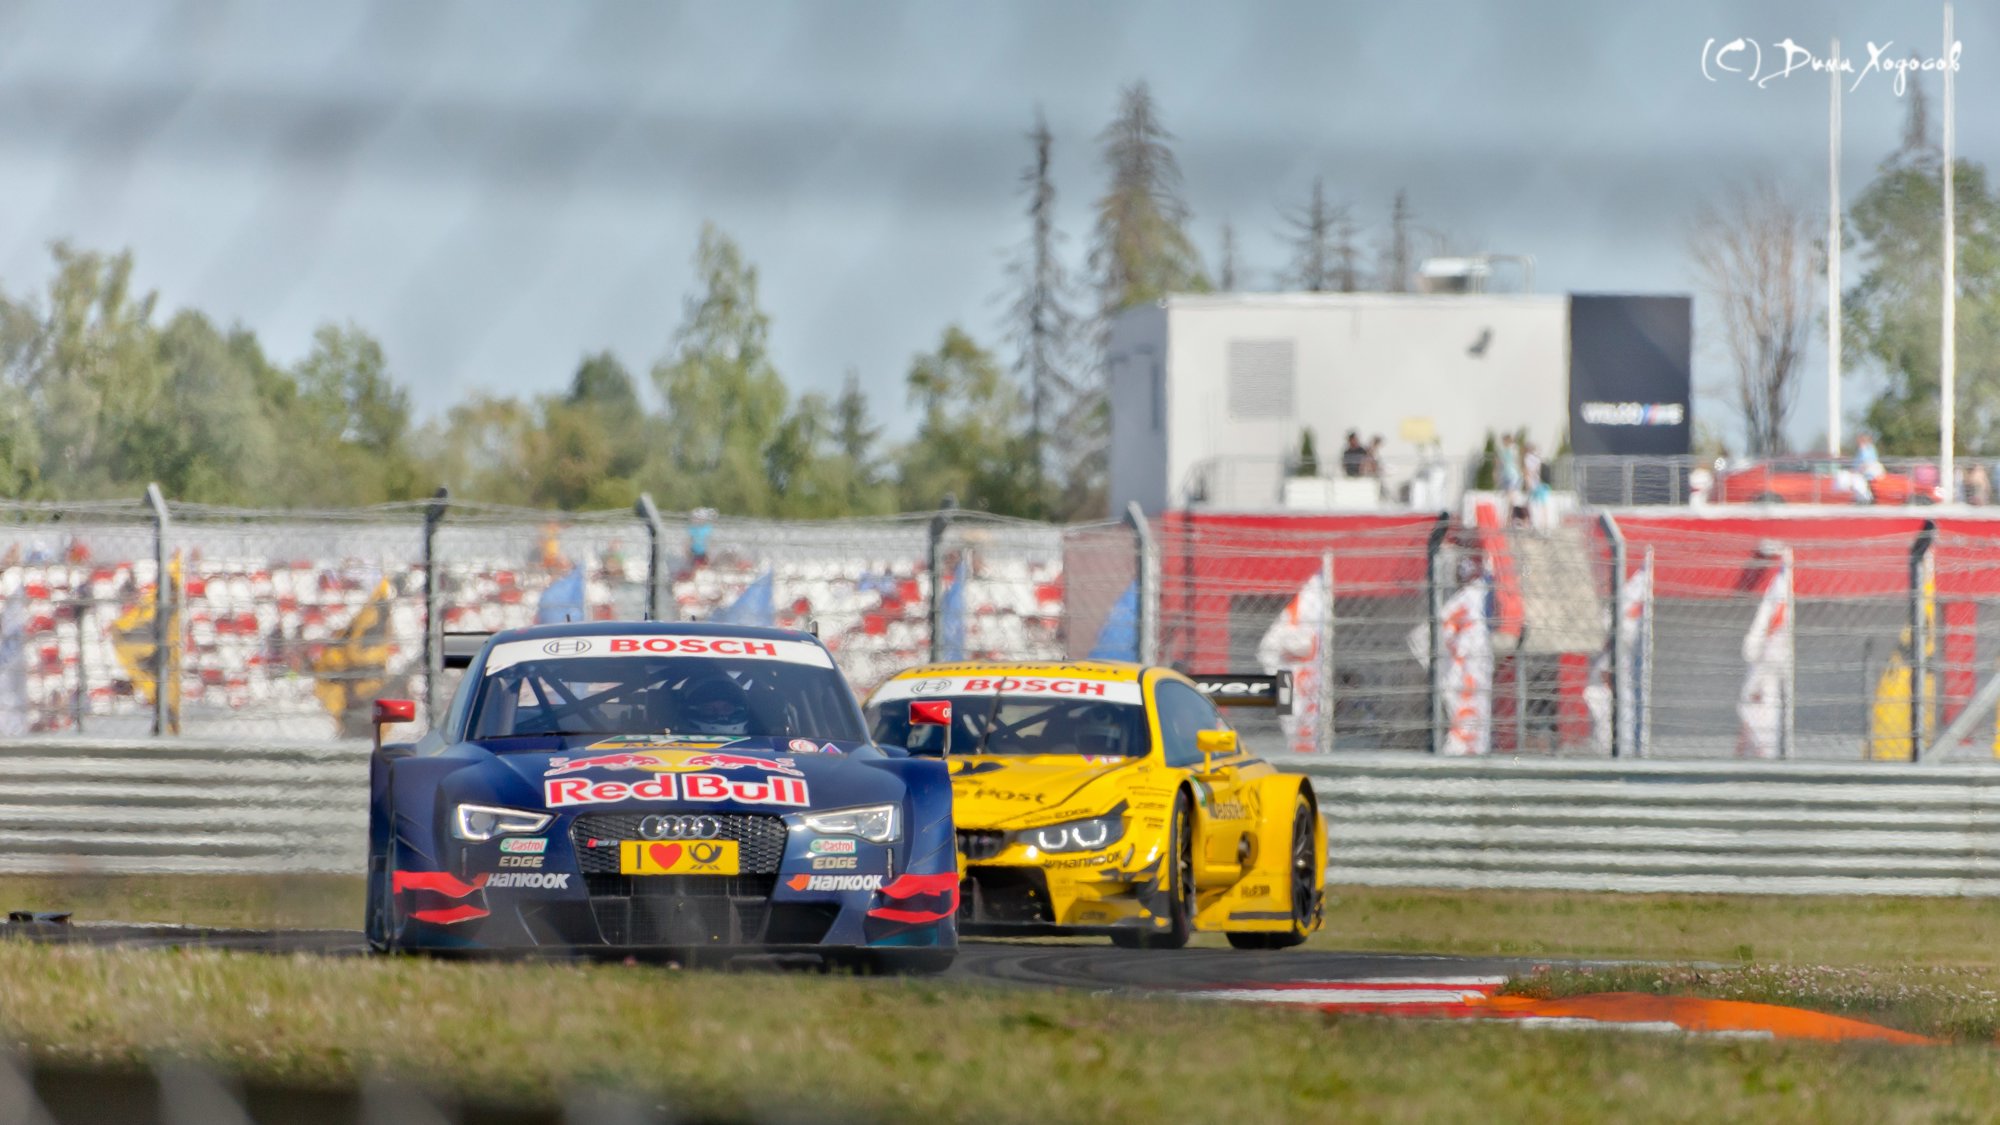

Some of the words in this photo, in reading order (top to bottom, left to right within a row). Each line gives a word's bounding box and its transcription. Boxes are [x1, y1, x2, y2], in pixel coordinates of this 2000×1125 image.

[609, 638, 777, 656] BOSCH
[962, 679, 1106, 696] BOSCH
[546, 773, 677, 807] Red
[682, 773, 810, 807] Bull
[511, 840, 546, 851] Castrol
[820, 840, 854, 852] Castrol
[498, 855, 545, 868] EDGE
[635, 844, 642, 870] I
[812, 856, 859, 870] EDGE
